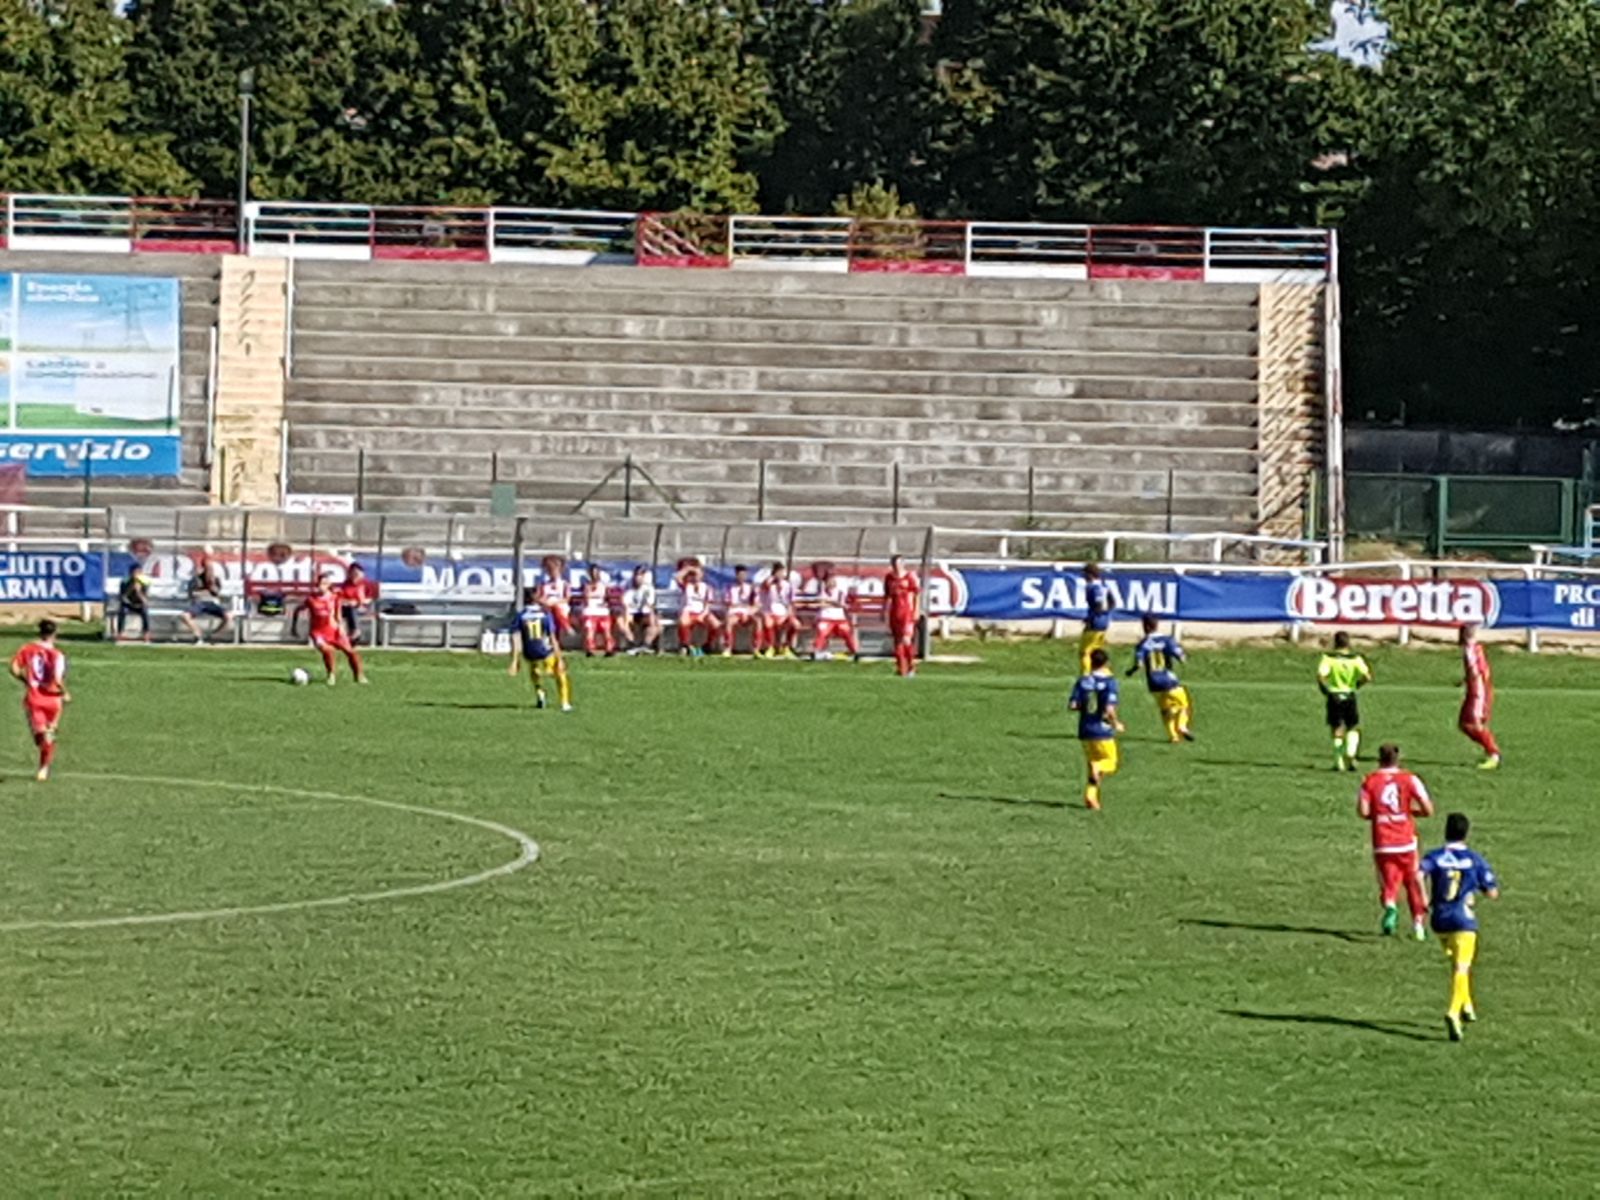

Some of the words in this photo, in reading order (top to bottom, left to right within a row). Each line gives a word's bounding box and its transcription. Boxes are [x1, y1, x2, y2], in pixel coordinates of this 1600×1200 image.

[1301, 576, 1485, 621] Beretta
[1380, 782, 1400, 813] 4
[1446, 870, 1462, 901] 7
